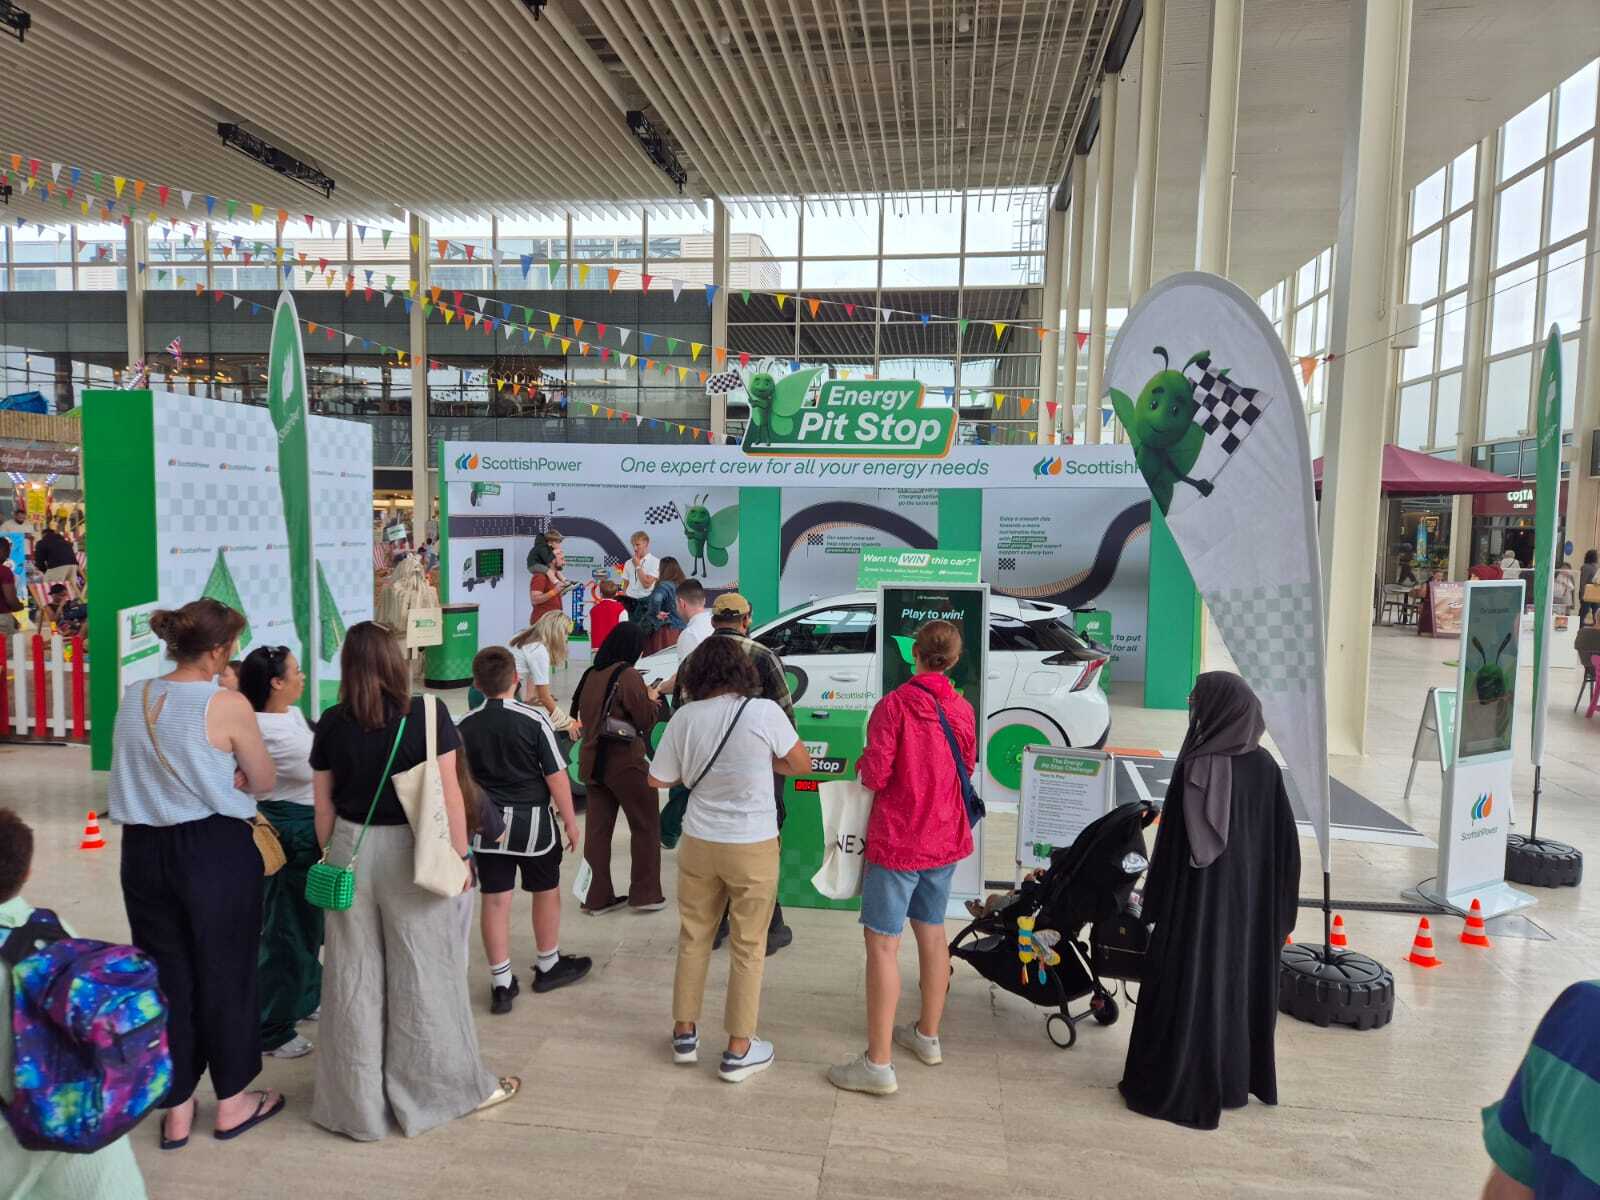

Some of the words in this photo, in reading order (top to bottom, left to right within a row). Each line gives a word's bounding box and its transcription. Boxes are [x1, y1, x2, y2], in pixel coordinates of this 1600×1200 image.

[827, 385, 914, 410] Energy
[797, 411, 849, 441] Pit
[854, 411, 942, 449] Stop
[481, 456, 583, 472] ScottishPower
[620, 456, 656, 473] One
[660, 458, 717, 477] expert
[719, 460, 764, 474] crew
[765, 458, 791, 475] for
[793, 458, 816, 475] all
[818, 462, 860, 479] your
[862, 461, 928, 479] energy
[929, 458, 990, 476] needs
[1507, 489, 1534, 502] COSTA
[863, 553, 887, 563] Want
[888, 554, 898, 564] to
[902, 554, 926, 565] WIN
[931, 556, 948, 565] this
[901, 608, 926, 621] Play
[927, 609, 939, 620] to
[941, 608, 965, 620] win!
[811, 758, 840, 773] Stop
